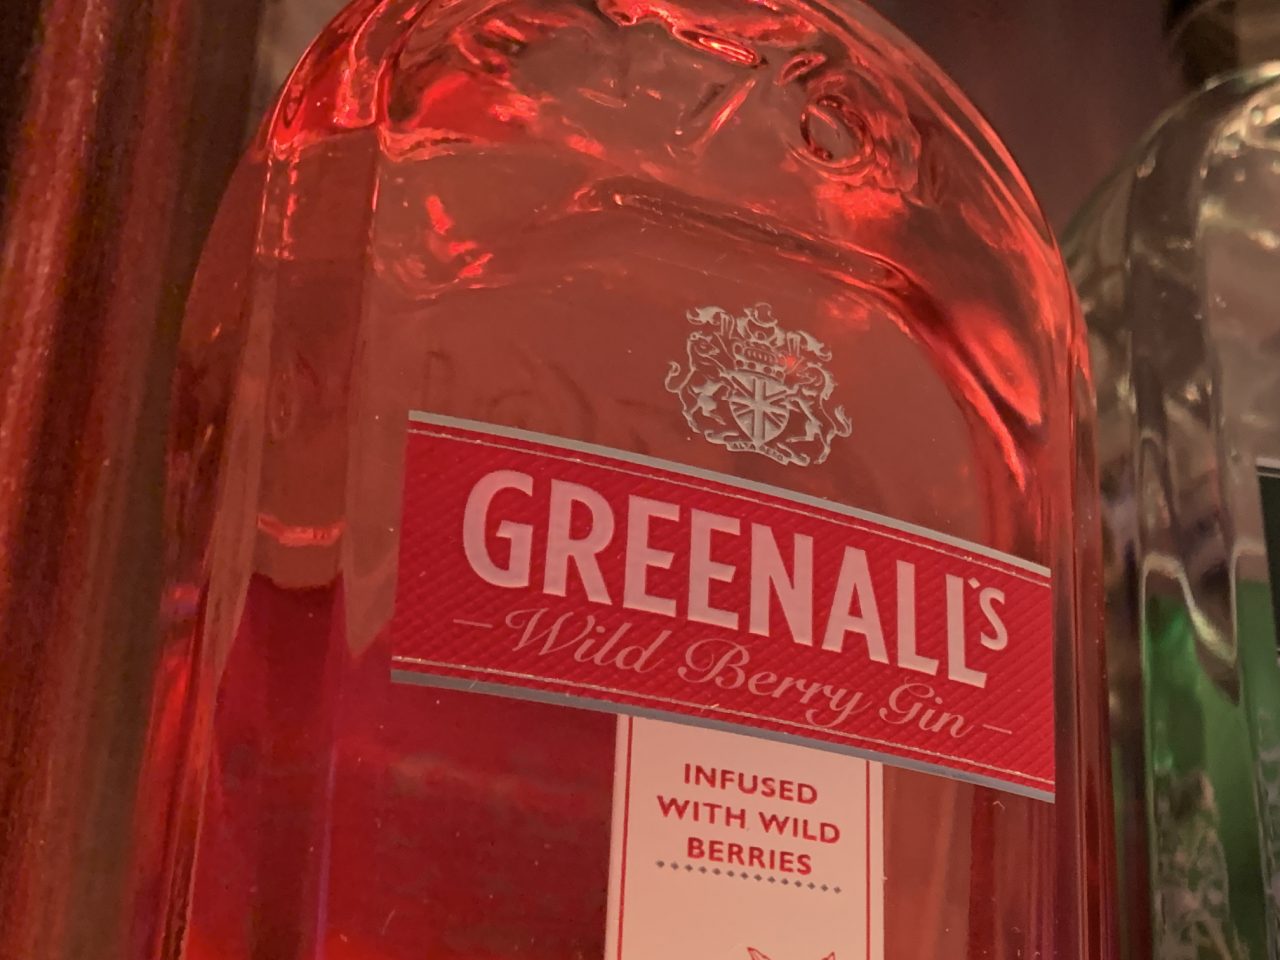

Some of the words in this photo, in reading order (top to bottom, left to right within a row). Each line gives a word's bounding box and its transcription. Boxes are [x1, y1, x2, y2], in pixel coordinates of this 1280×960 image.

[505, 608, 664, 674] Wild
[678, 637, 872, 728] Berry
[880, 678, 975, 739] Gin
[684, 763, 818, 804] INFUSED
[657, 795, 746, 829] WITH
[759, 811, 841, 843] WILD
[687, 836, 813, 875] BERRIES
